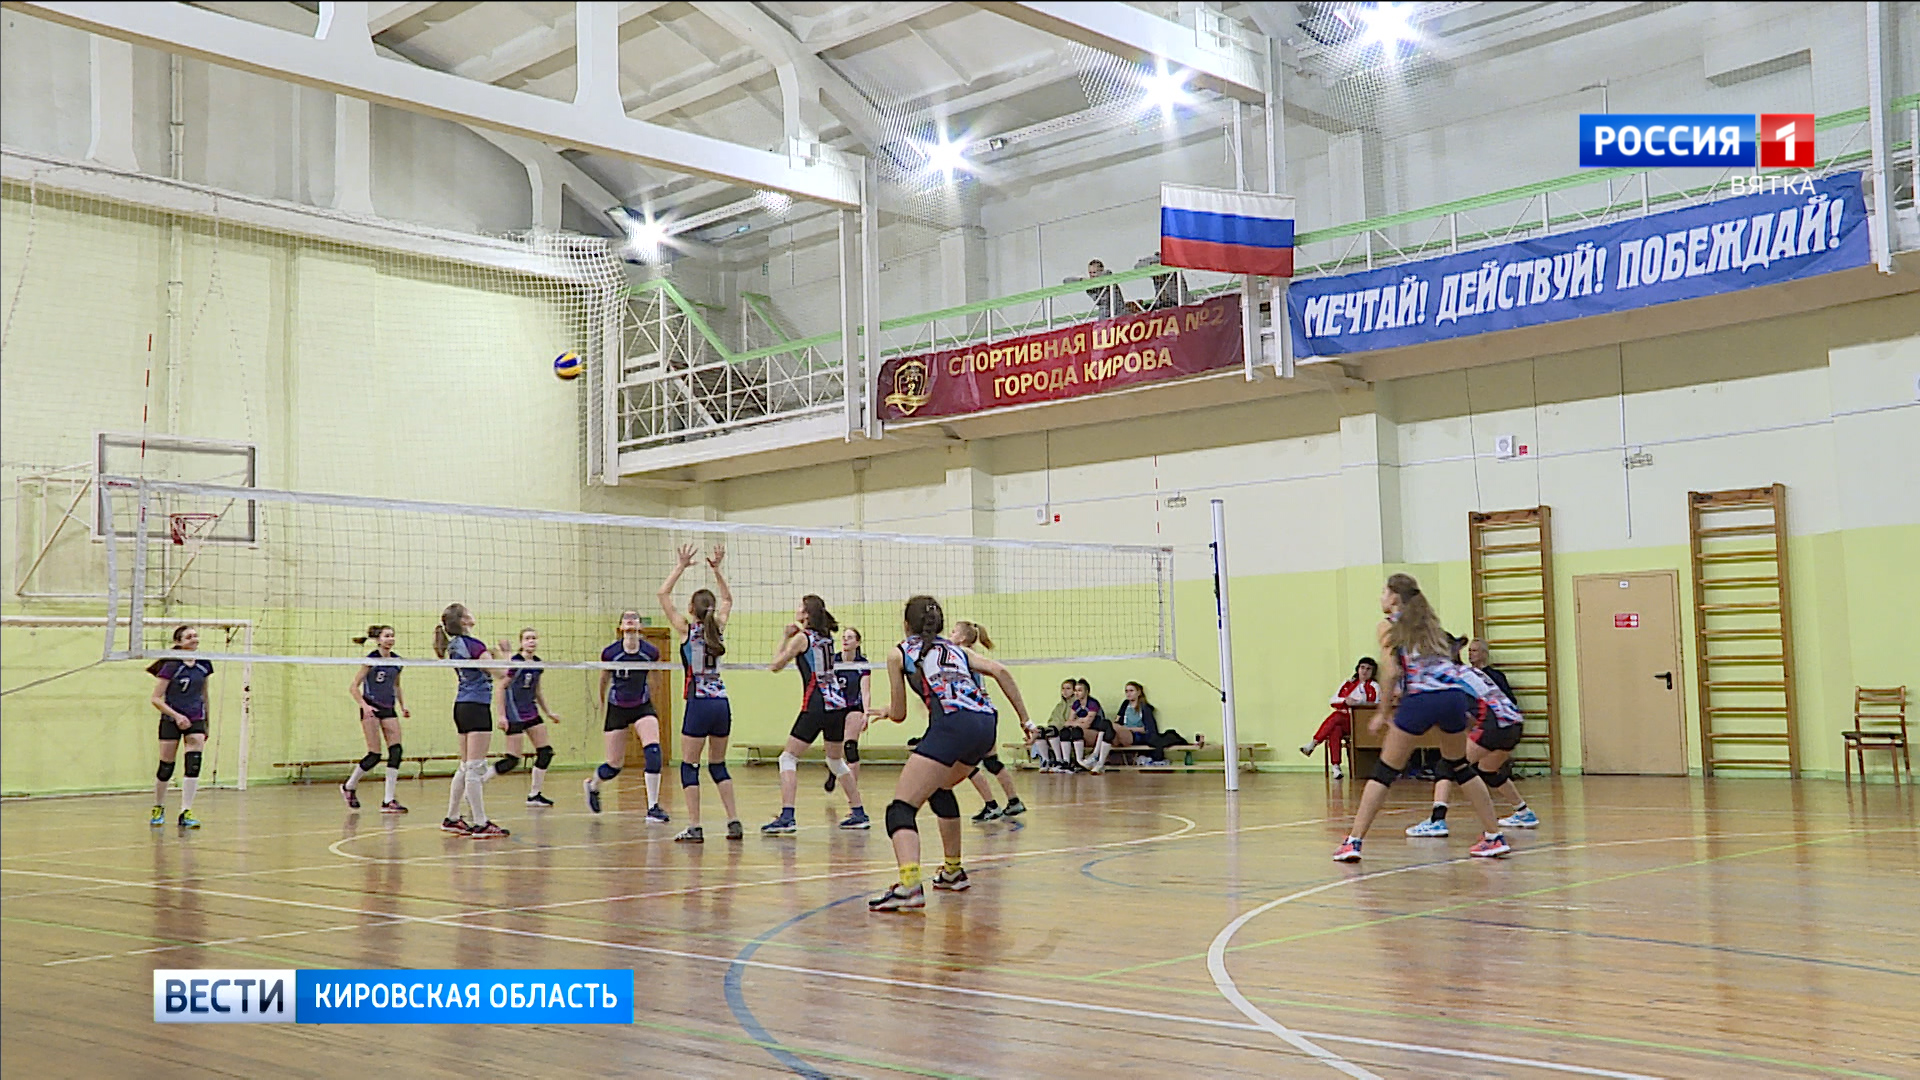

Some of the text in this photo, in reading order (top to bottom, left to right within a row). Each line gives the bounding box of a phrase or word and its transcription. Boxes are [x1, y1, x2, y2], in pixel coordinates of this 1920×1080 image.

[1303, 193, 1846, 338] МЕЧТАЙ! ДЕЙСТВУЙ! ПОБЕЖДАЙ!
[948, 305, 1226, 376] СПОРТИВНАЯ ШКОЛА №2
[993, 346, 1173, 399] ГОРОДА КИРОВА
[179, 677, 191, 692] 7
[838, 676, 848, 689] 2
